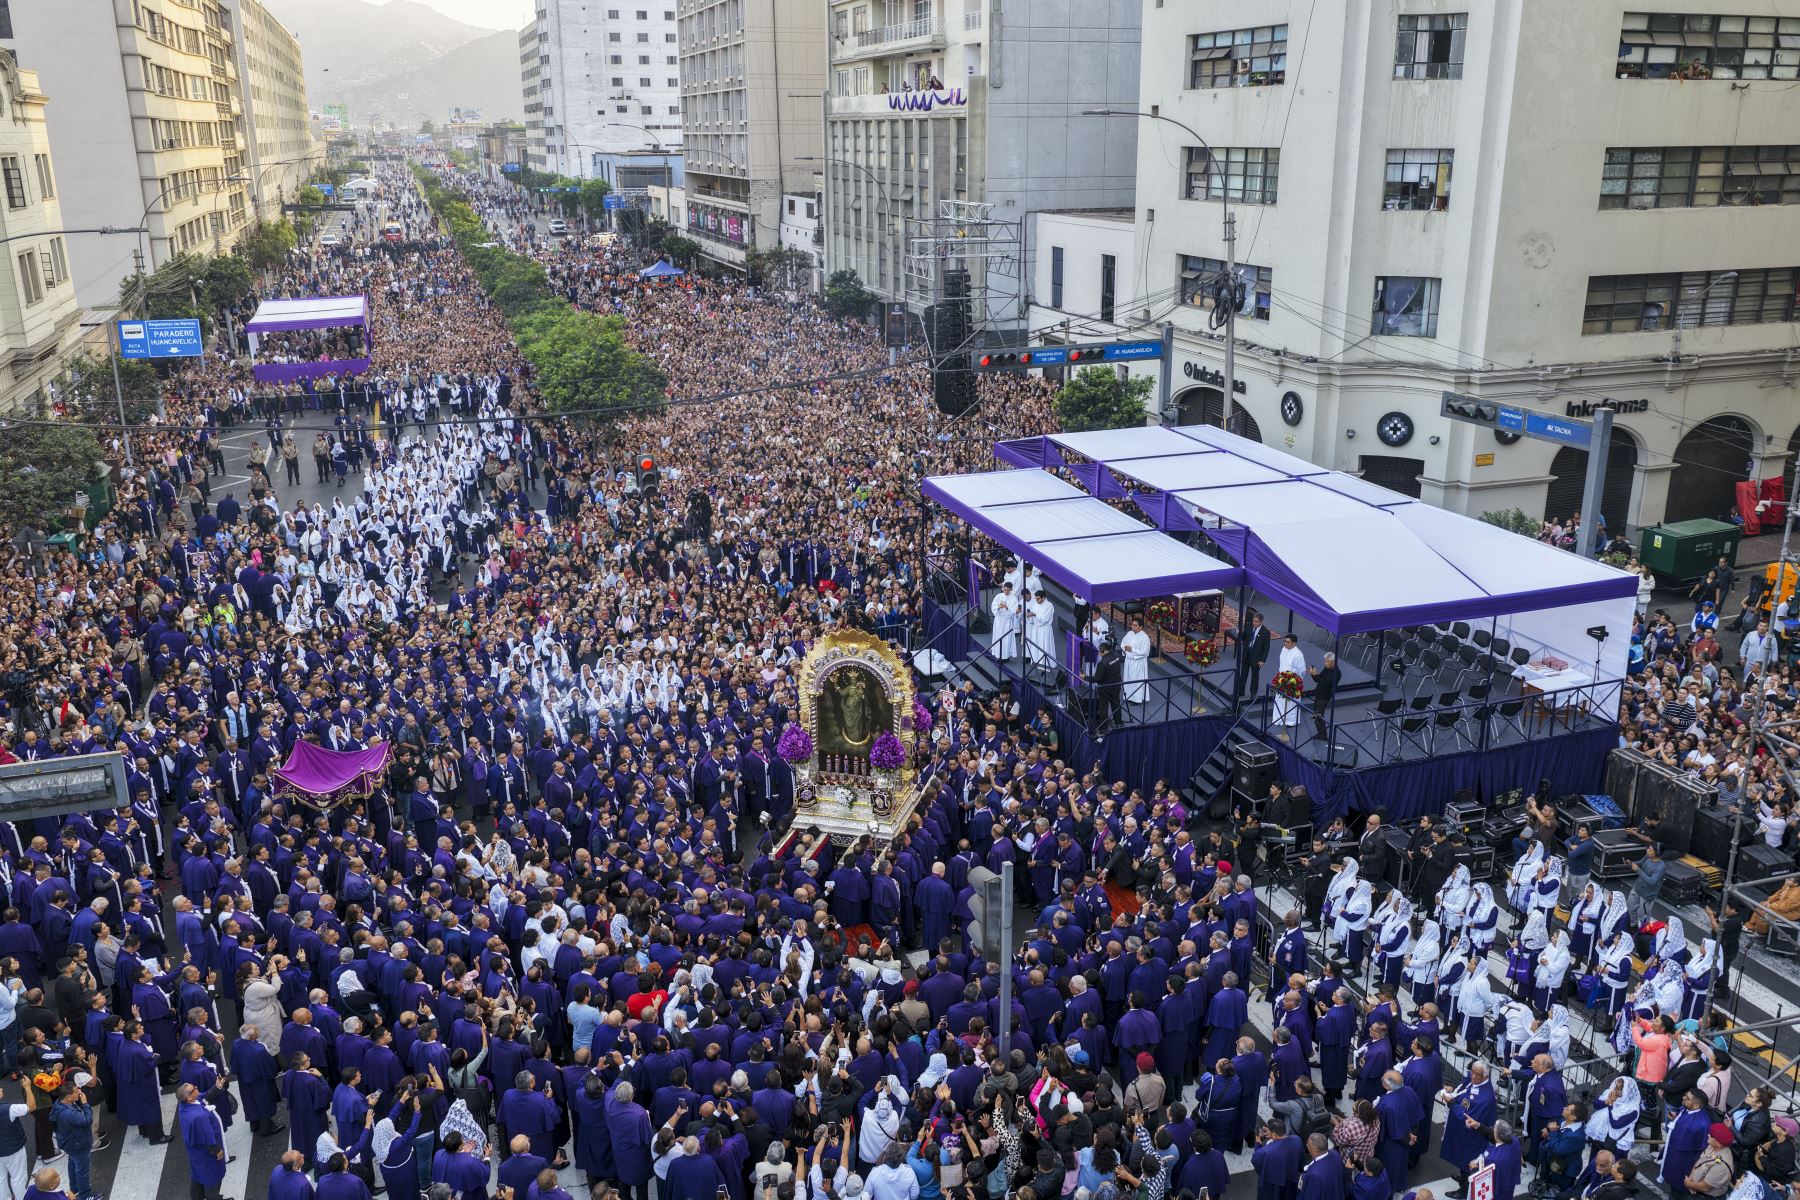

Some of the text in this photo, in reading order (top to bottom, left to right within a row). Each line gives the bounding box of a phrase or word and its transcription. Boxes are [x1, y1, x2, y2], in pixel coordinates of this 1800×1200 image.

[153, 330, 194, 338] PARADERO
[1193, 363, 1246, 395] Inkafama
[1554, 425, 1572, 436] TACNA
